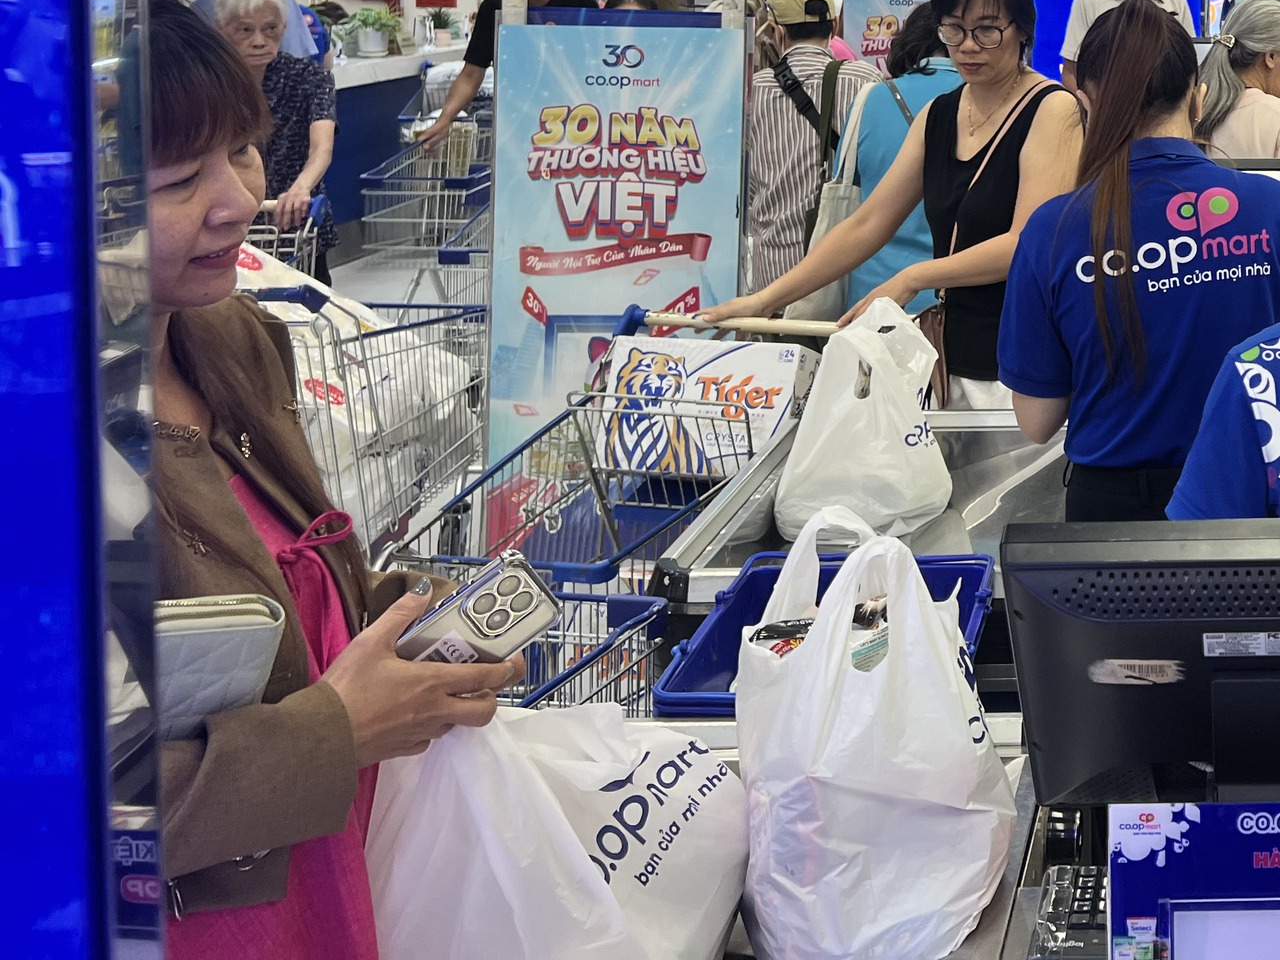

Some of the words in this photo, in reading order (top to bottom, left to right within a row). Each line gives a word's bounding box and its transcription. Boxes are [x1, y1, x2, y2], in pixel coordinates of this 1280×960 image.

[863, 15, 899, 40] 30
[602, 44, 645, 68] 30
[585, 74, 661, 89] co.opmart
[532, 104, 600, 146] 30
[609, 107, 701, 151] NĂM
[528, 146, 642, 173] THƯƠNG
[647, 146, 708, 179] HIỆU
[557, 172, 678, 234] VIỆT
[525, 254, 561, 270] Người
[562, 256, 583, 270] Nội
[584, 253, 602, 268] Trợ
[603, 248, 625, 261] Của
[627, 242, 656, 258] Nhân
[659, 242, 684, 253] Dân
[1147, 276, 1180, 293] bạn
[1183, 269, 1213, 287] của
[1216, 264, 1242, 281] mọi
[1245, 261, 1271, 277] nhà
[784, 349, 795, 358] 24
[695, 373, 784, 420] Tiger
[705, 432, 748, 443] CRYSTA
[634, 852, 663, 887] bạn
[657, 820, 682, 852] của
[697, 762, 728, 798] nhà
